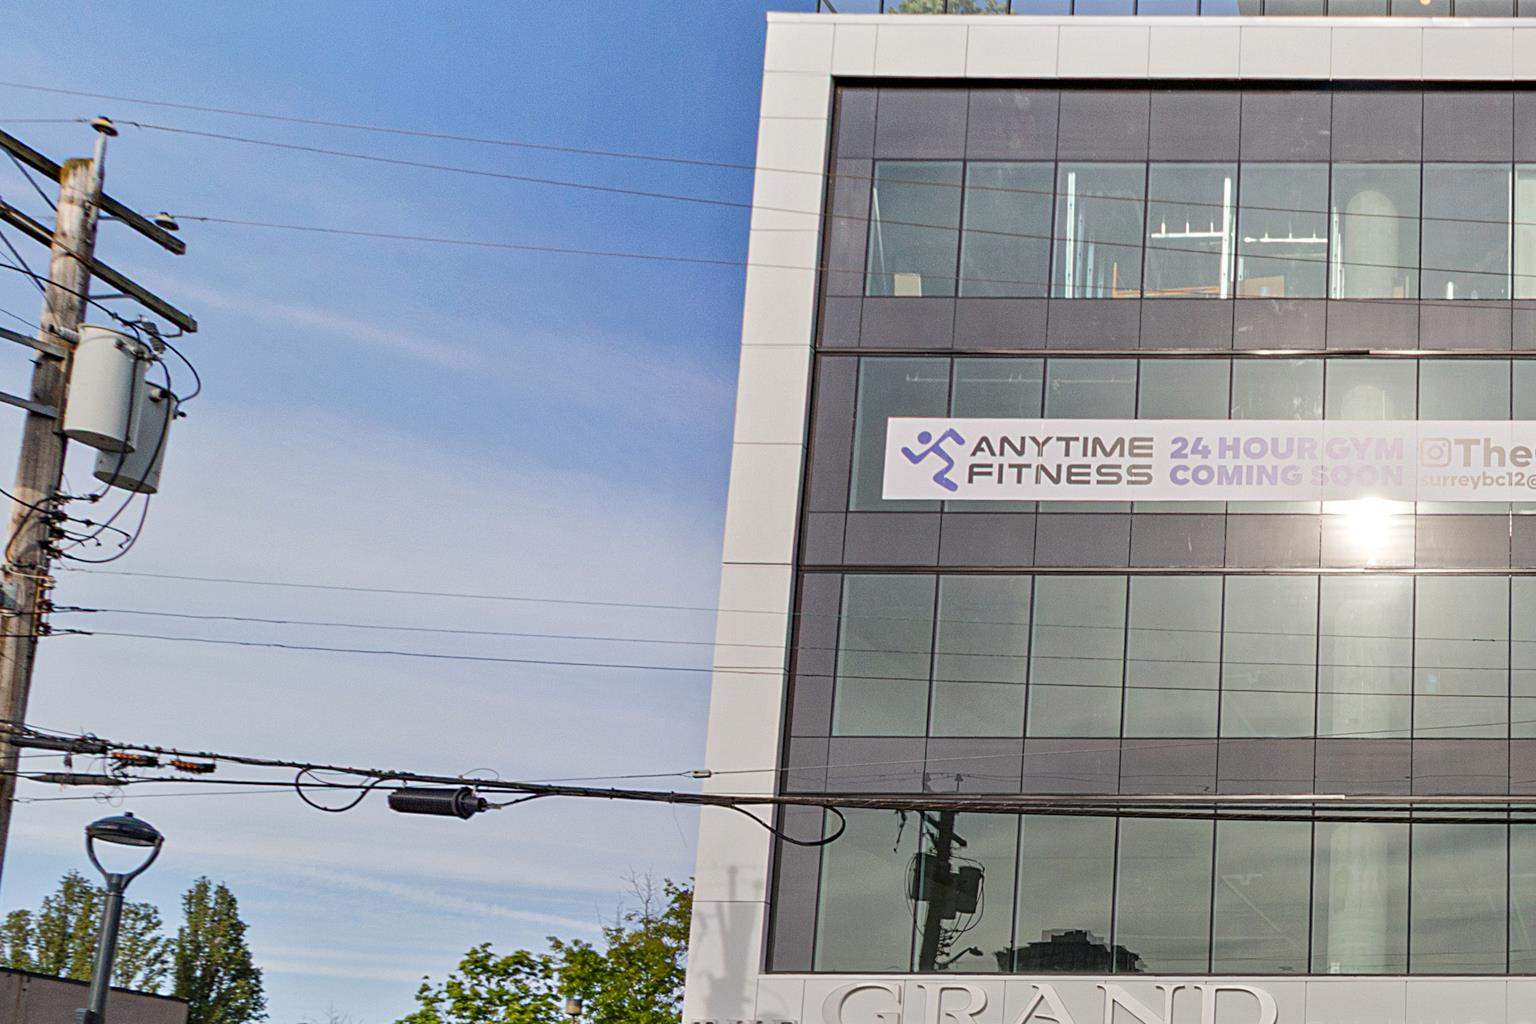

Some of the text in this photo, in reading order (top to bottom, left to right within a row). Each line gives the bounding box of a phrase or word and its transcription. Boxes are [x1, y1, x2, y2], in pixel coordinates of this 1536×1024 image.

[970, 436, 1154, 458] ANYTIME
[1169, 436, 1404, 460] 24 HOUR GYM
[967, 463, 1153, 485] FITNESS
[1169, 464, 1403, 486] COMING SOON
